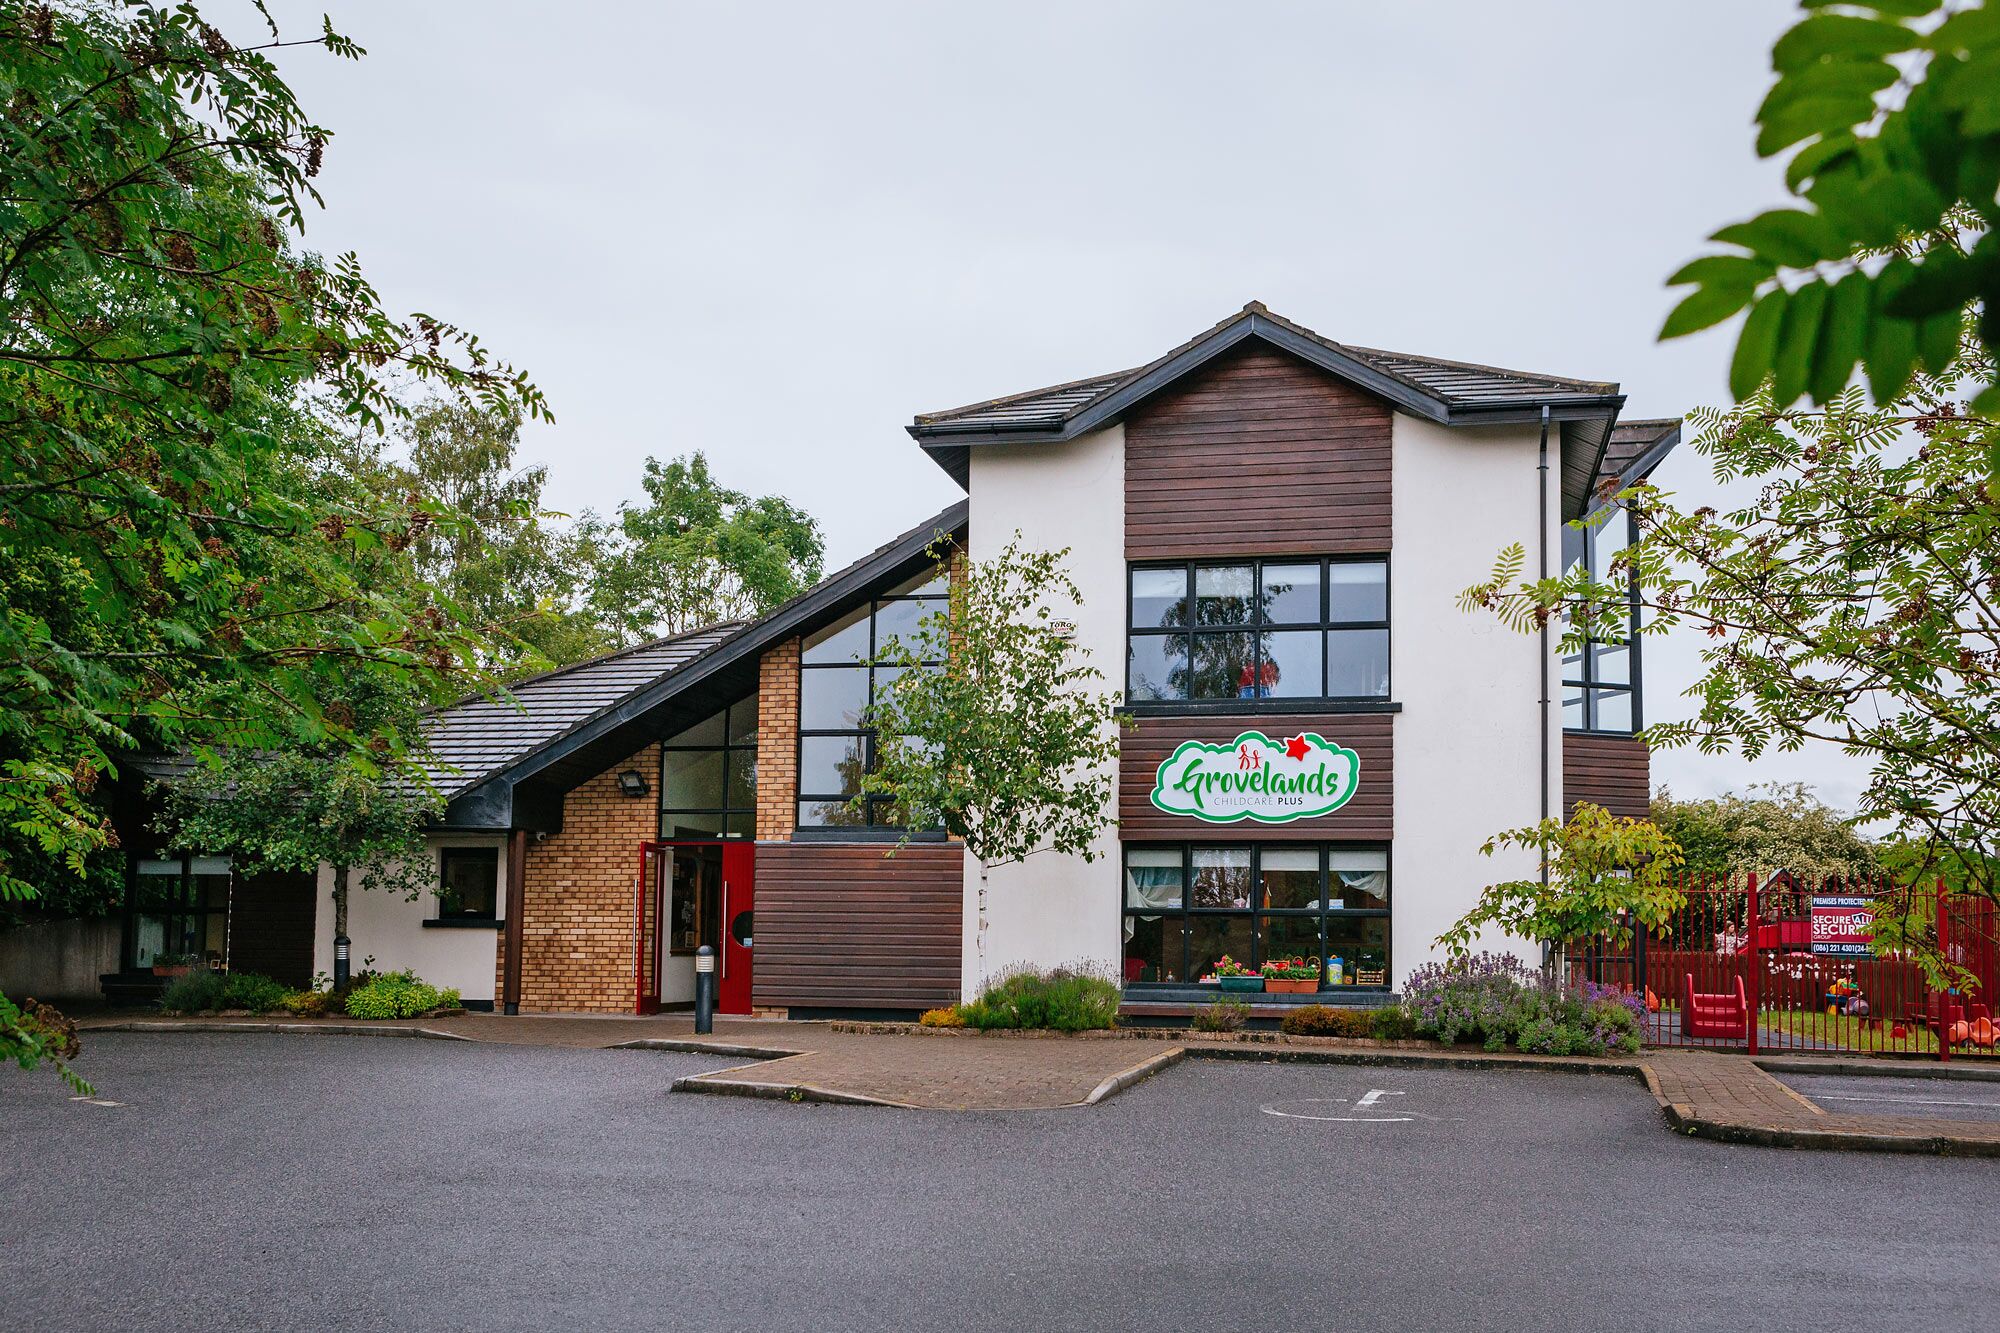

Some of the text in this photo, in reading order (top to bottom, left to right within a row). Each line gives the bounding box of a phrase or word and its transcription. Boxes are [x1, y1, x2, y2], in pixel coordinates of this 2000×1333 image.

[1172, 758, 1339, 809] Grovelands
[1213, 797, 1304, 806] CHILDCARE PLUS
[1813, 897, 1837, 905] PREMISES
[1813, 915, 1851, 924] SECURE
[1813, 924, 1873, 936] SECUR
[1830, 944, 1840, 952] 221
